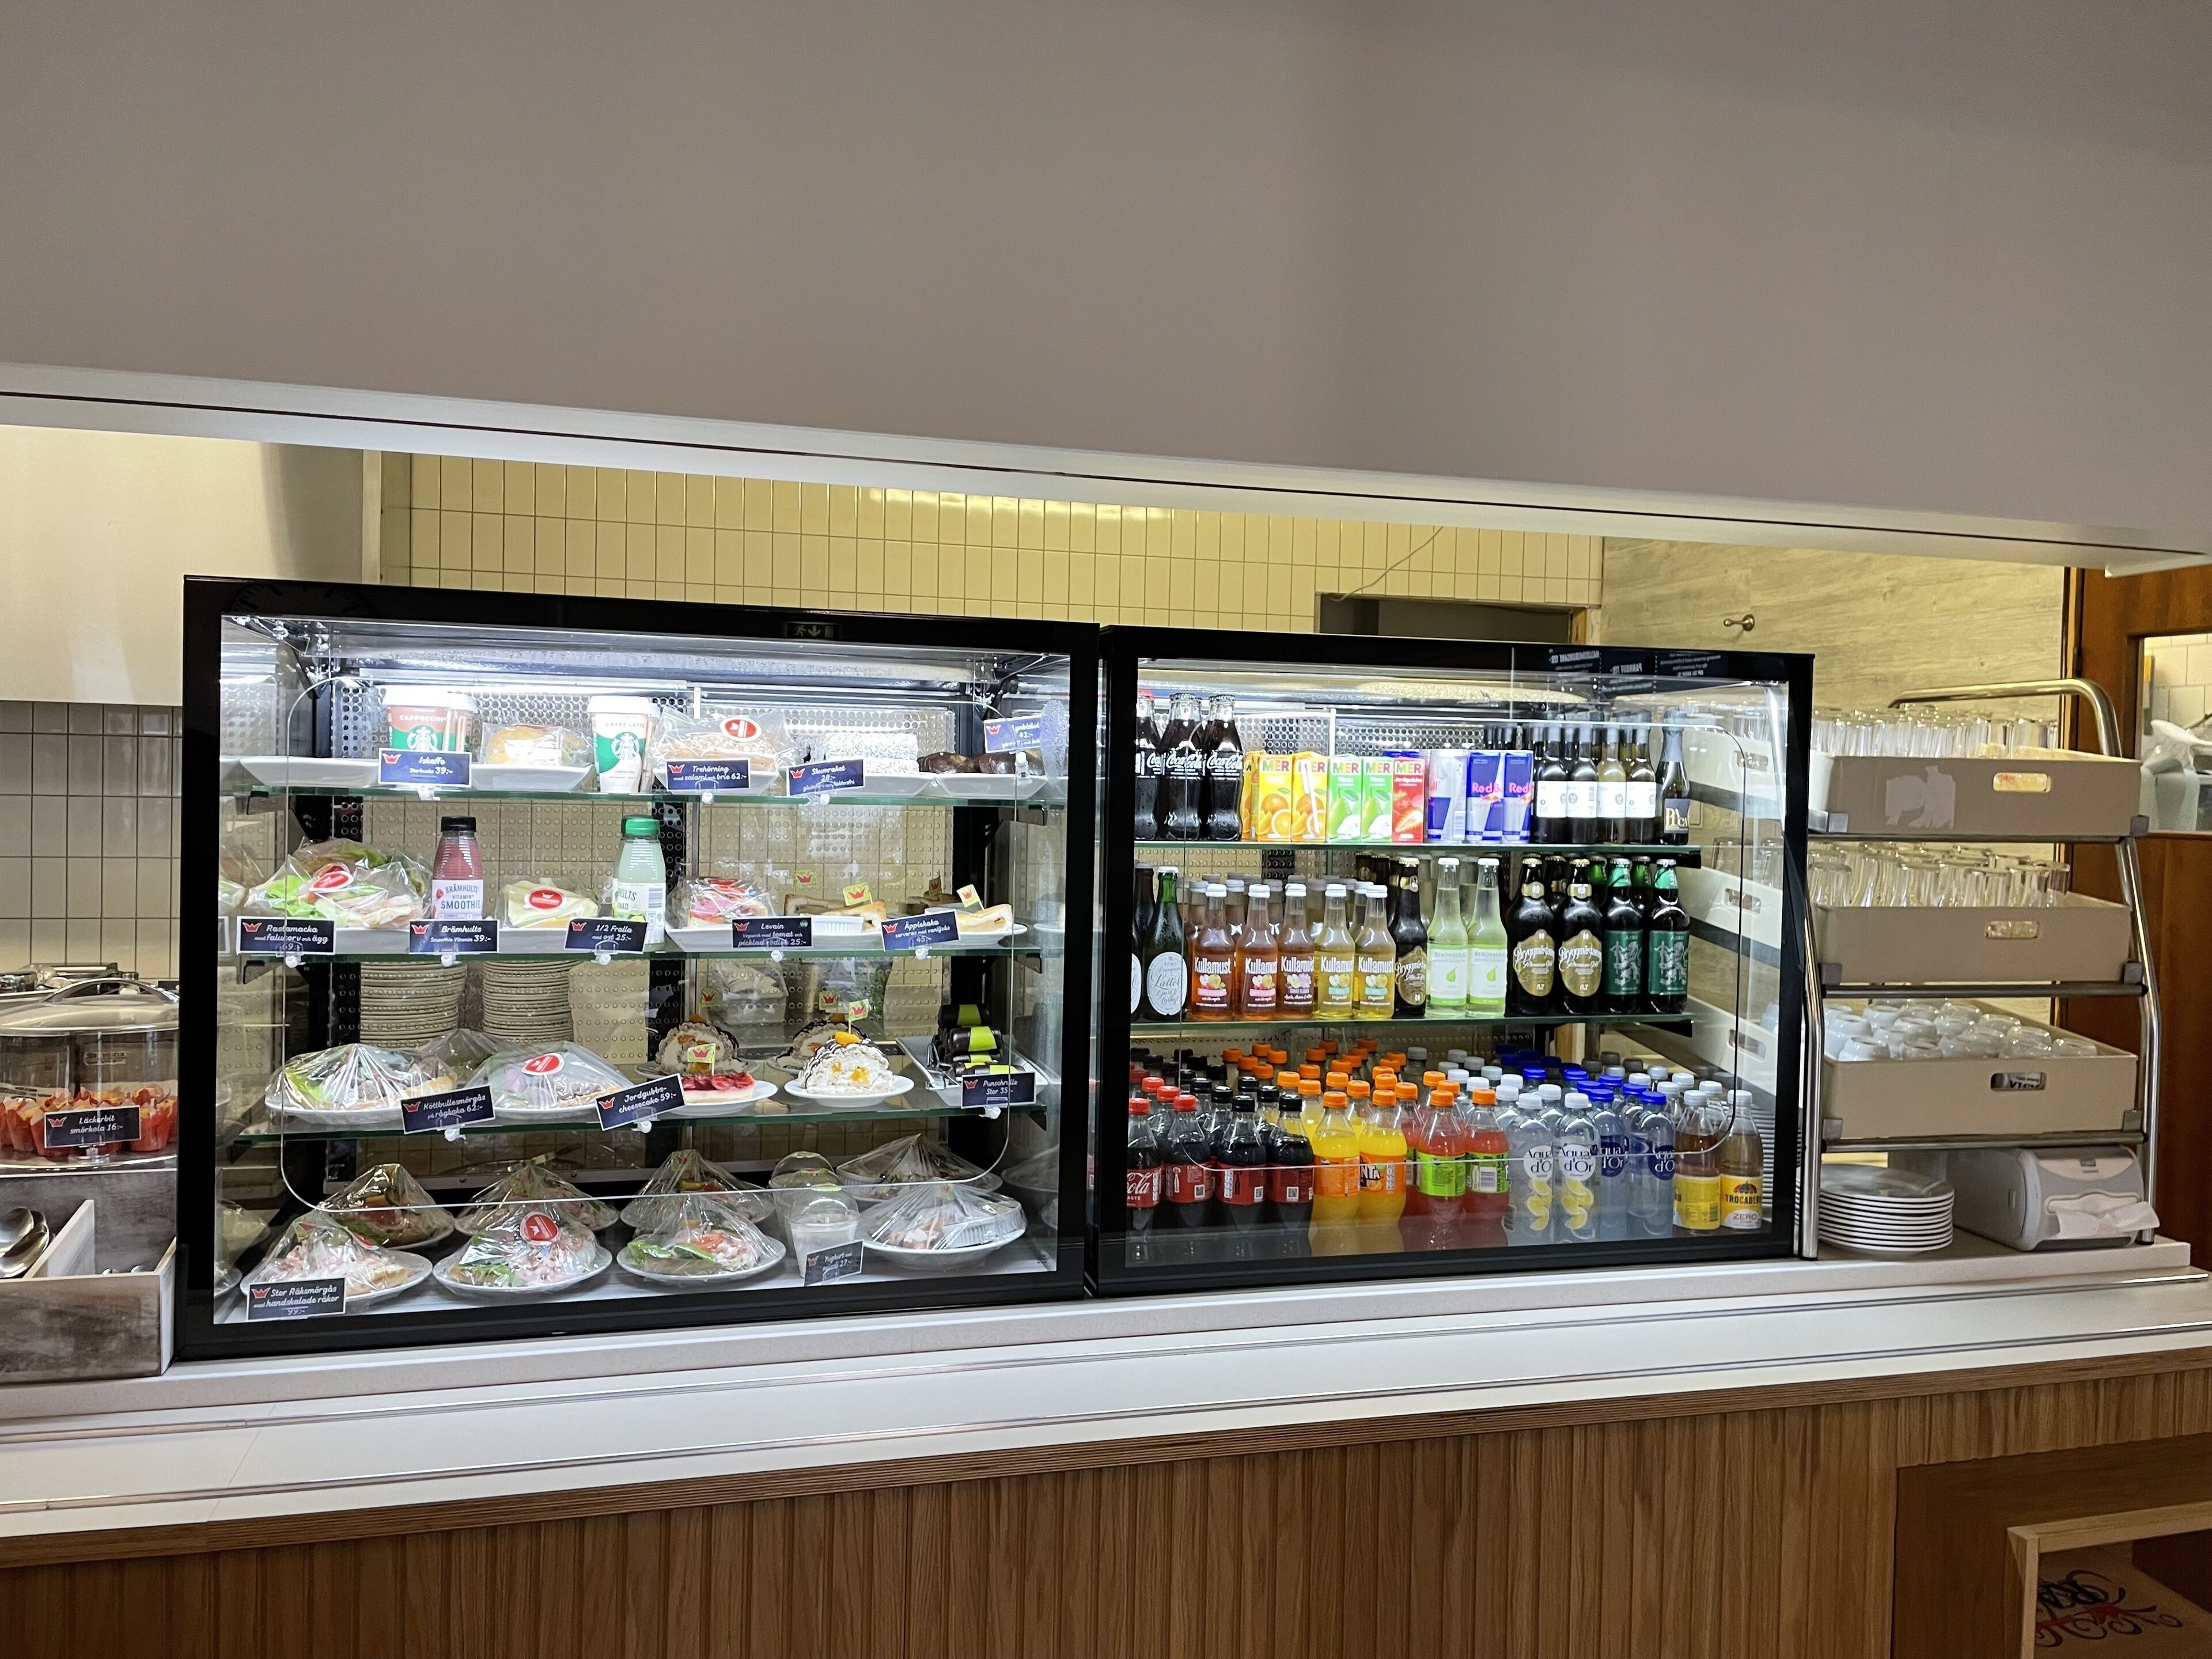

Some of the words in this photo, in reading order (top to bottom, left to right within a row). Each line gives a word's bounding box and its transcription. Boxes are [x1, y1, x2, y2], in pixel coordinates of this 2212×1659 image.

[399, 714, 448, 722] CAPPUCCIN
[435, 766, 453, 775] 39:-
[692, 765, 730, 774] Trehörning
[1262, 759, 1290, 772] MER
[1332, 762, 1360, 774] MER
[1366, 762, 1391, 774] MER
[1396, 762, 1422, 774] MER
[1472, 782, 1493, 793] Red
[1509, 782, 1529, 793] Red
[445, 884, 479, 893] BRÄMHULTS
[441, 900, 480, 910] SMOOTHIE
[441, 925, 482, 933] Brämhults
[610, 925, 633, 933] Fralla
[312, 934, 329, 945] ägg
[474, 934, 491, 942] 39:-
[615, 933, 632, 941] 25:-
[737, 938, 765, 948] picklad
[1194, 956, 1232, 974] Kullamust
[624, 1086, 668, 1103] Jordgubbs-
[423, 1093, 486, 1111] Köttbullesmörgås
[618, 1096, 660, 1114] cheesecake
[660, 1092, 677, 1102] 59:-
[435, 1107, 465, 1119] rågkaka
[467, 1104, 483, 1112] 62:-
[79, 1114, 115, 1124] Läckerbit
[70, 1125, 105, 1134] smörkola
[1531, 1159, 1552, 1173] d'O
[1564, 1158, 1593, 1173] d'Or
[1654, 1159, 1675, 1172] d'O
[1361, 1164, 1380, 1179] NTA
[270, 1289, 287, 1297] Stor
[289, 1284, 338, 1296] Räksmörgås
[265, 1296, 317, 1308] handskalade
[317, 1294, 340, 1303] räkor
